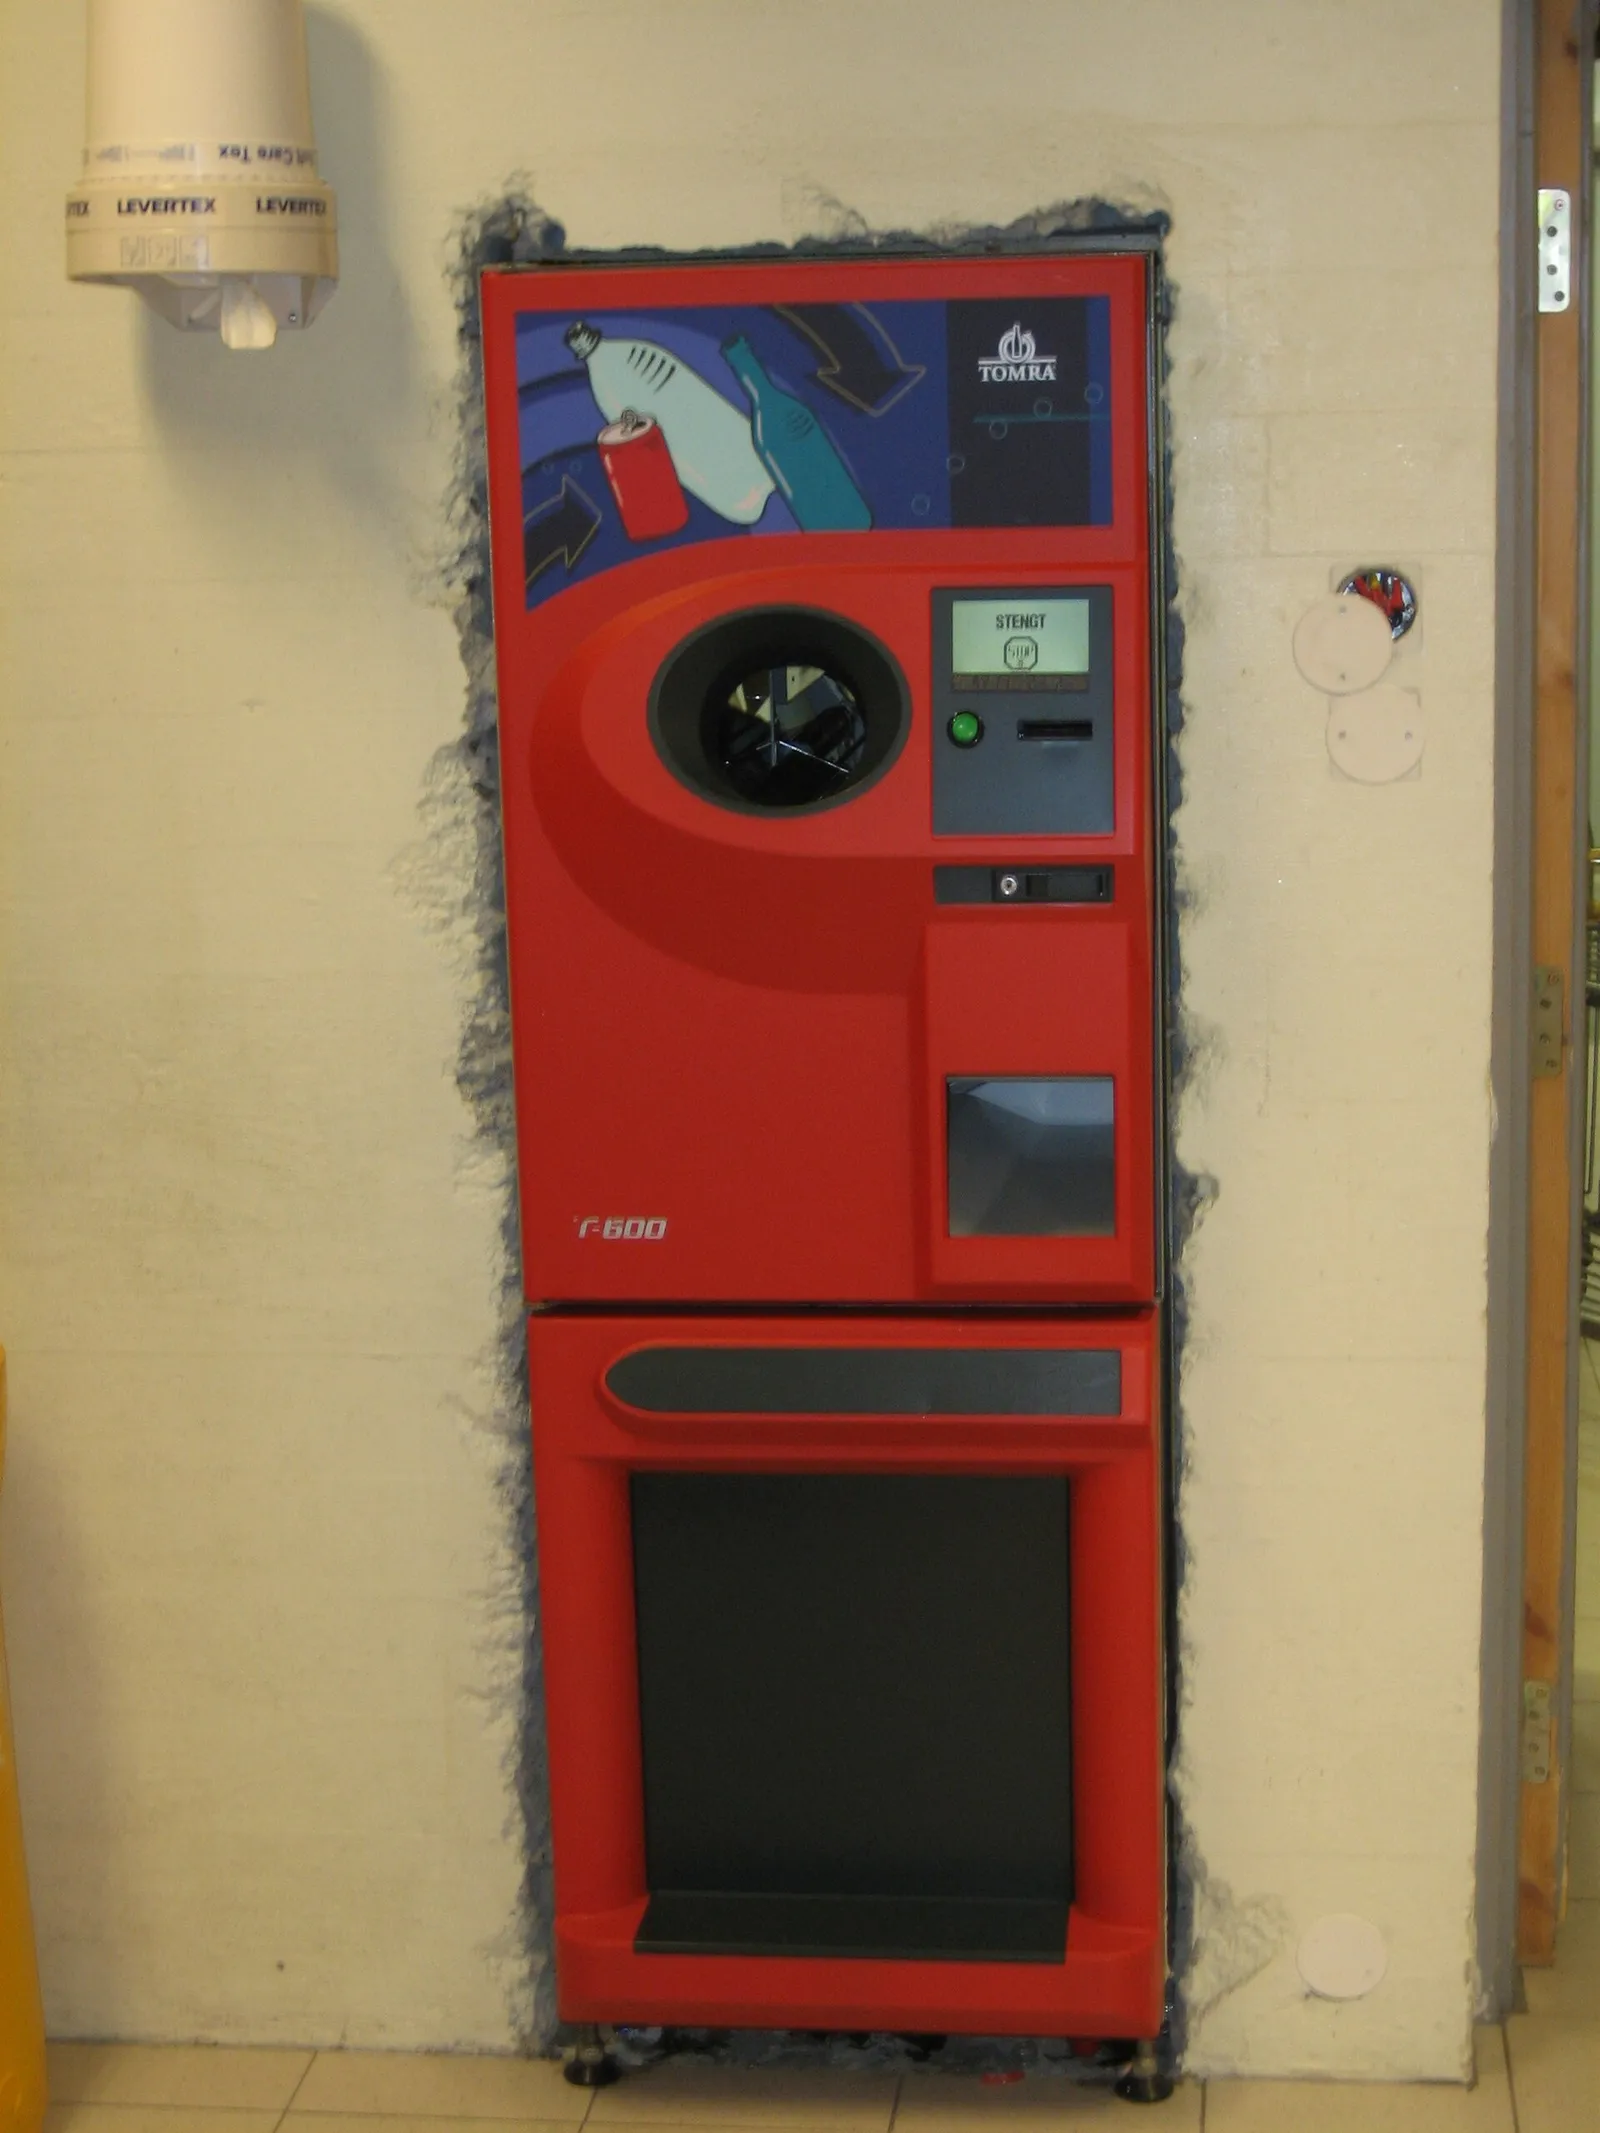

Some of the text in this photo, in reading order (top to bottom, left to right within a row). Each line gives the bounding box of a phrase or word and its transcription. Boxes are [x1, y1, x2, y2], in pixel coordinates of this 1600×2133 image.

[117, 197, 216, 215] LEVERTEX
[977, 364, 1057, 382] TOMRA
[995, 613, 1047, 630] STENGT
